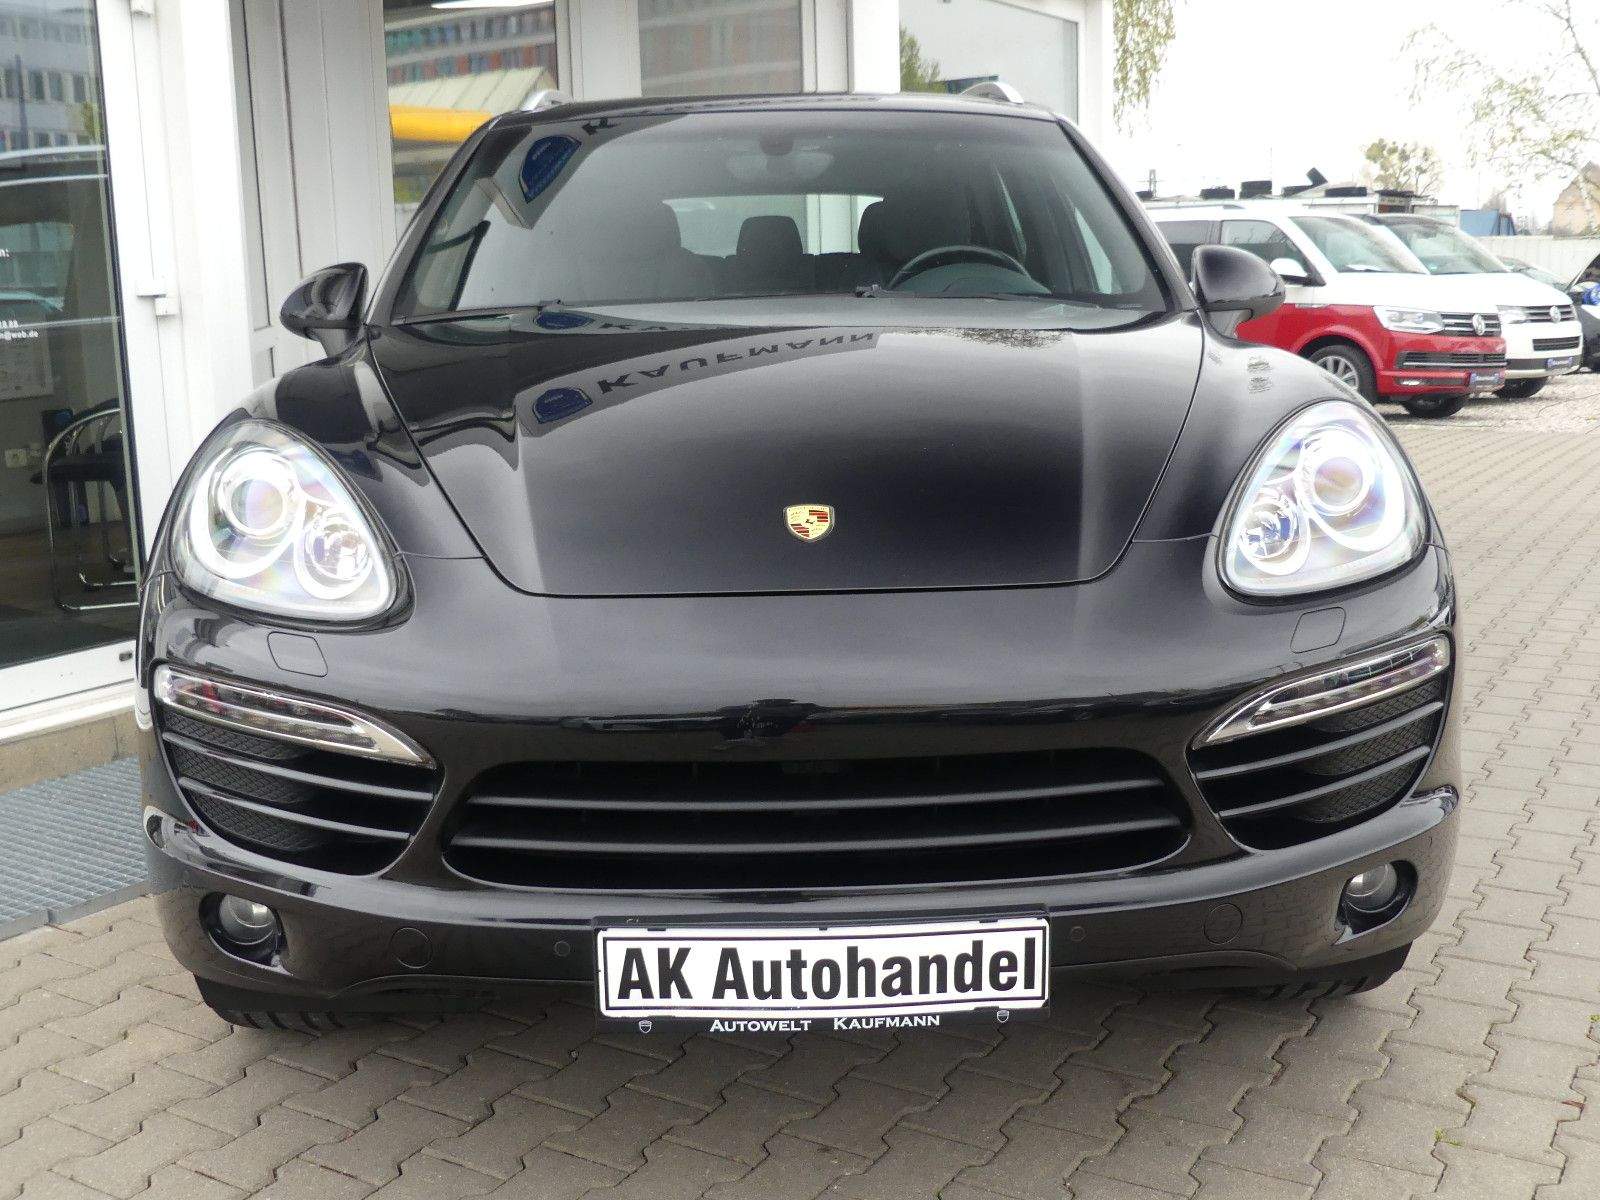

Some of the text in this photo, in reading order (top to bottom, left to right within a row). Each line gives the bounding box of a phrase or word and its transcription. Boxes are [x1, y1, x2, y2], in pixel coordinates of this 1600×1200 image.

[617, 937, 1036, 1000] AK Autohandel
[709, 1014, 940, 1033] AUTOWELT KAUFMANN
